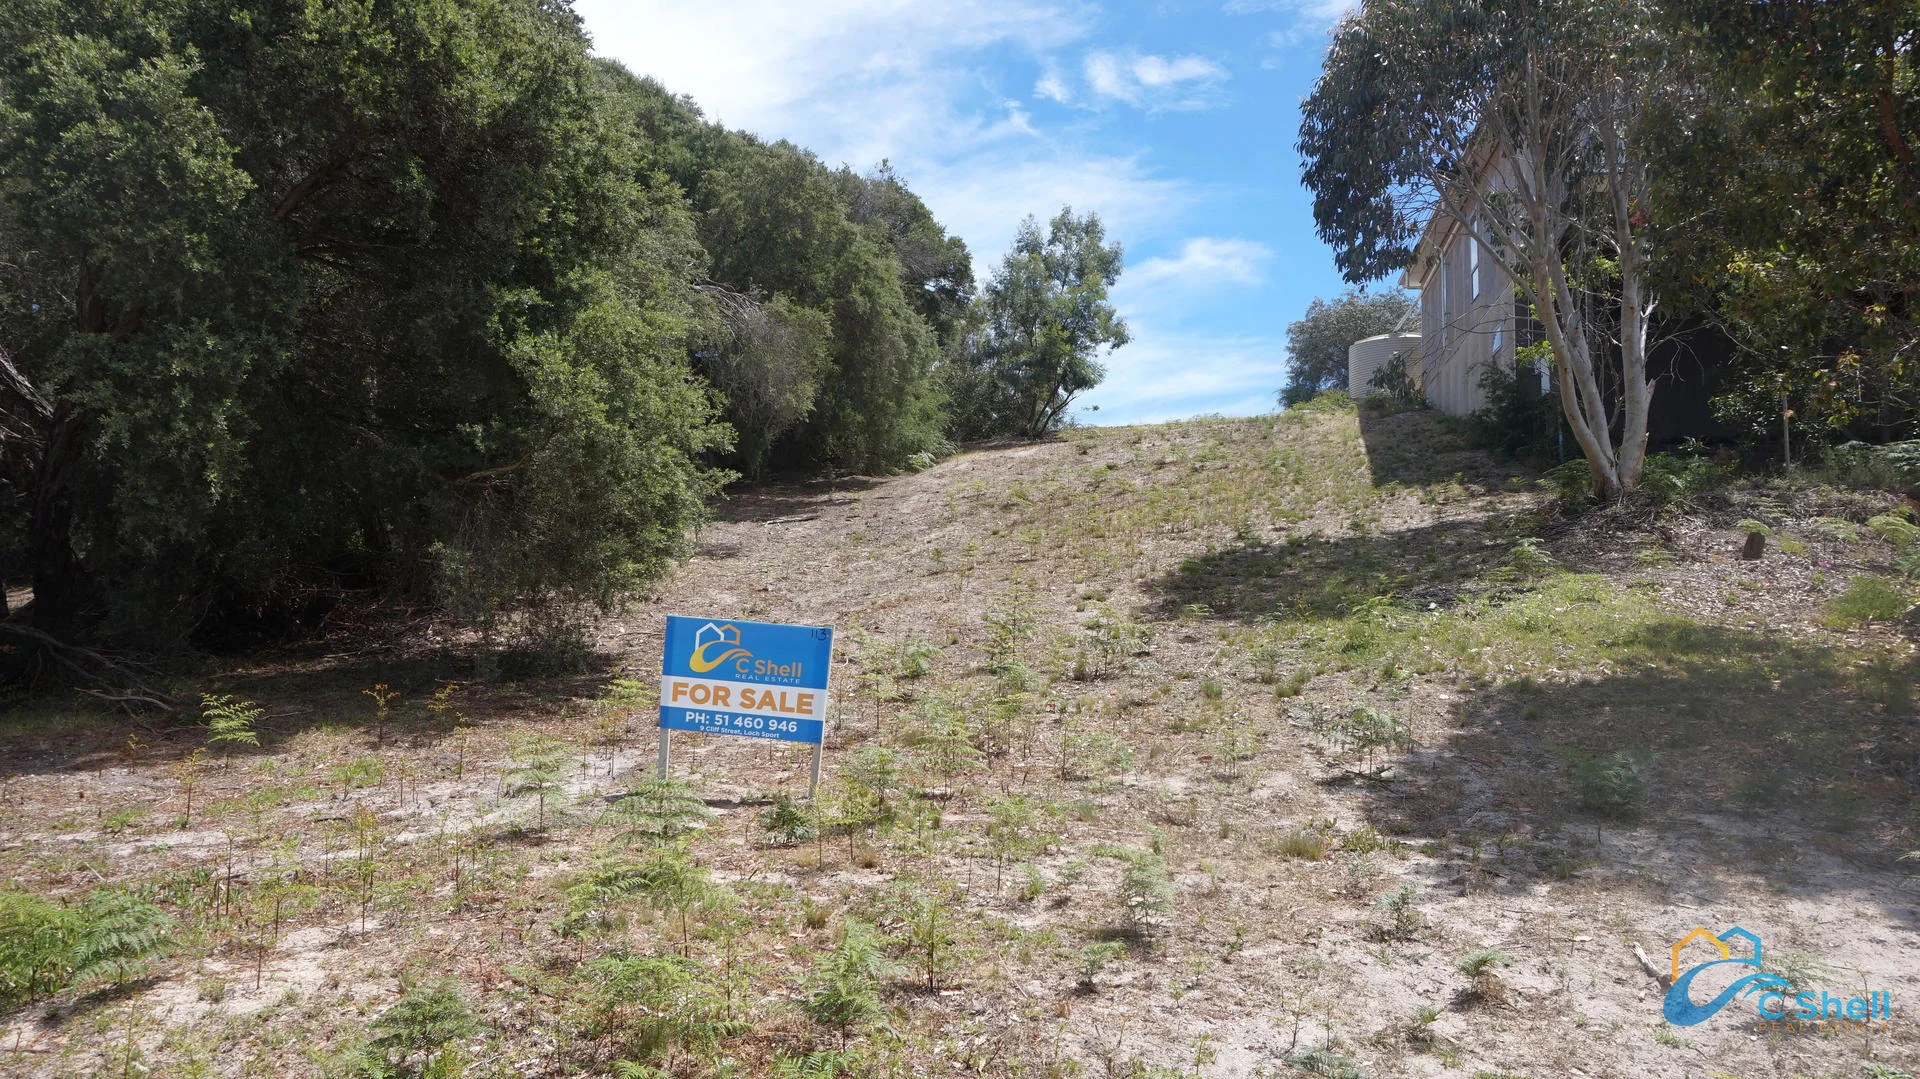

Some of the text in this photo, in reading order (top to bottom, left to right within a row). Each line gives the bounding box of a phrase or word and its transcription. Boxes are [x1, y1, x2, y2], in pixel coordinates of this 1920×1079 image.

[736, 658, 803, 678] C Shell
[735, 673, 801, 684] REAL ESTATE
[671, 681, 815, 715] FOR SALE
[685, 712, 798, 733] PH: 51 460 946
[721, 727, 742, 735] Street,
